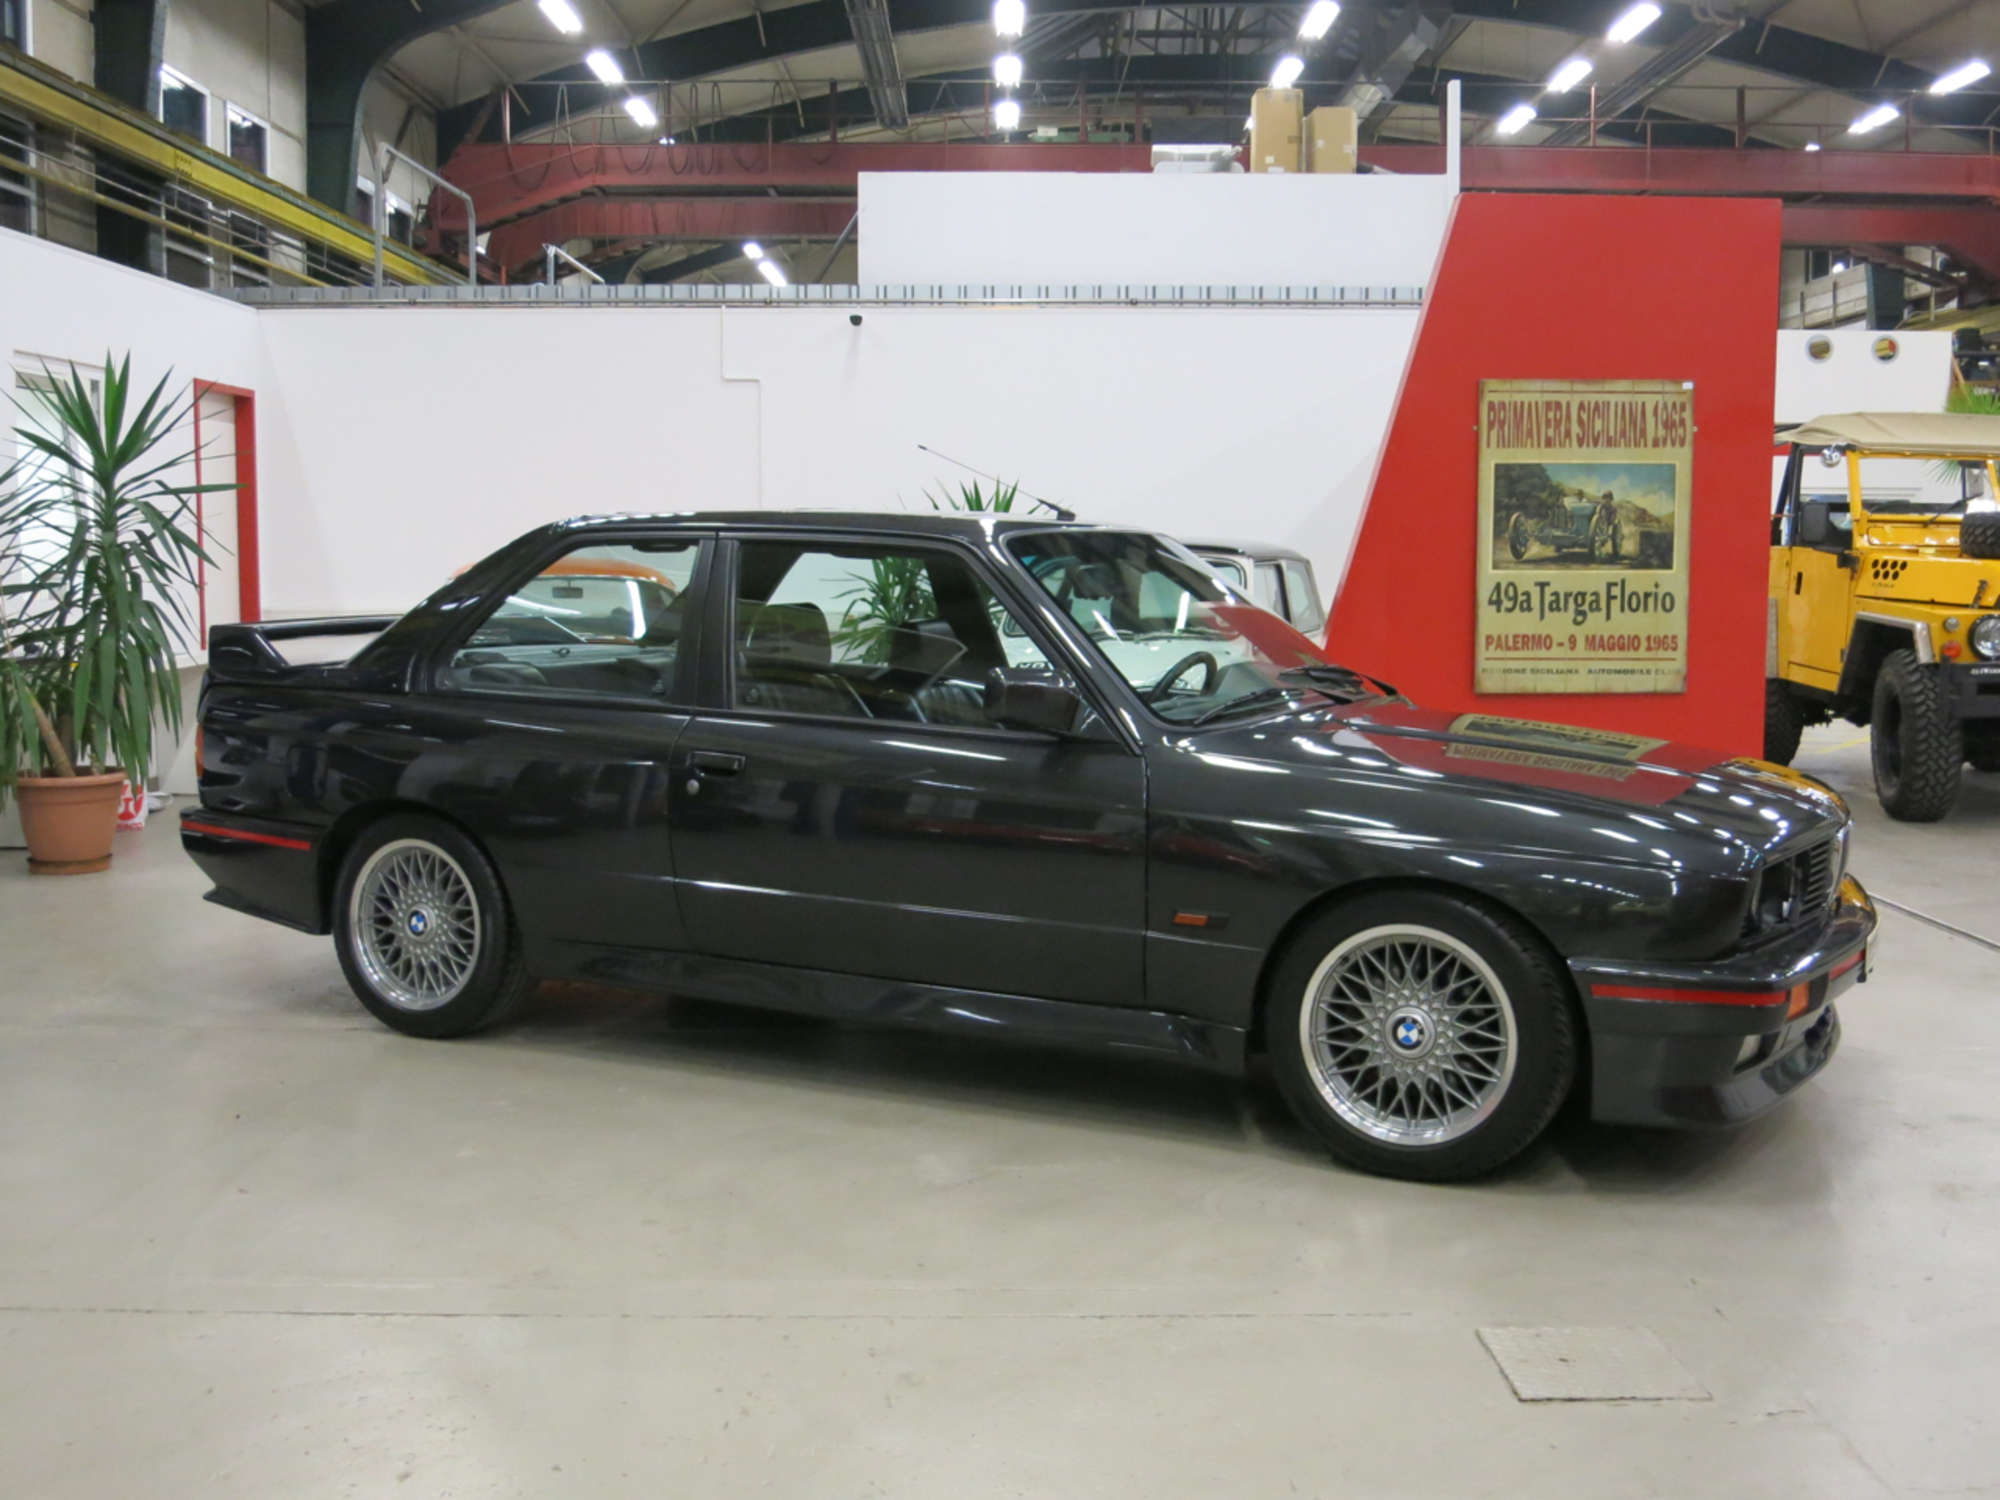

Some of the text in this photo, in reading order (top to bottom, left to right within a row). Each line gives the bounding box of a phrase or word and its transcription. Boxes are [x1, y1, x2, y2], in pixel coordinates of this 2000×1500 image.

[1486, 400, 1687, 448] PRIMAVERA SICILIANA 1965
[1488, 578, 1676, 626] 49a Targa Florio
[1485, 633, 1553, 651] PALERMO
[1568, 634, 1577, 651] 9
[1585, 634, 1641, 652] MAGGIO
[1645, 634, 1679, 652] 1965
